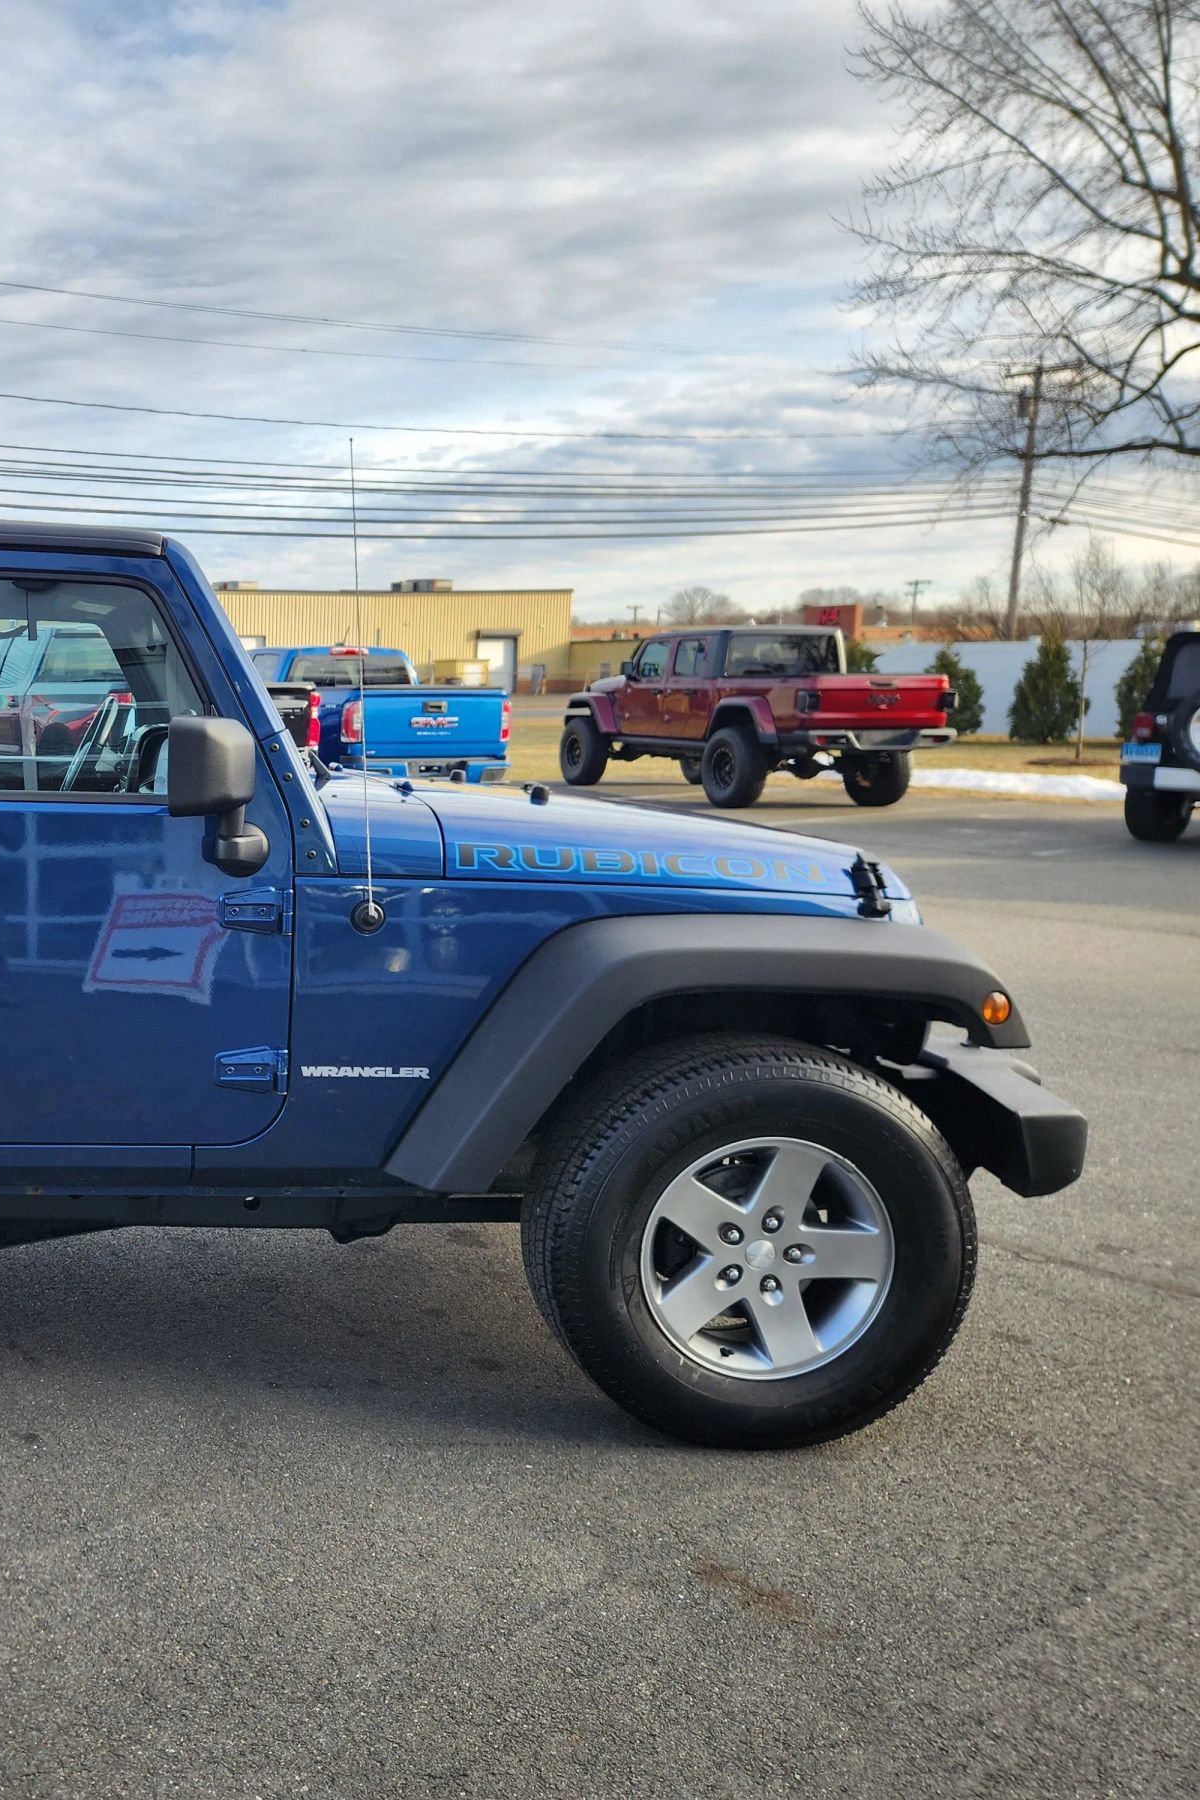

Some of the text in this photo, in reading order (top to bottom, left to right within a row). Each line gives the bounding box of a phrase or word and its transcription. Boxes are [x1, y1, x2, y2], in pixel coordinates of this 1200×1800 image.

[411, 717, 459, 728] GMC
[455, 841, 826, 883] RUBICON
[300, 1066, 431, 1079] WRANGLER
